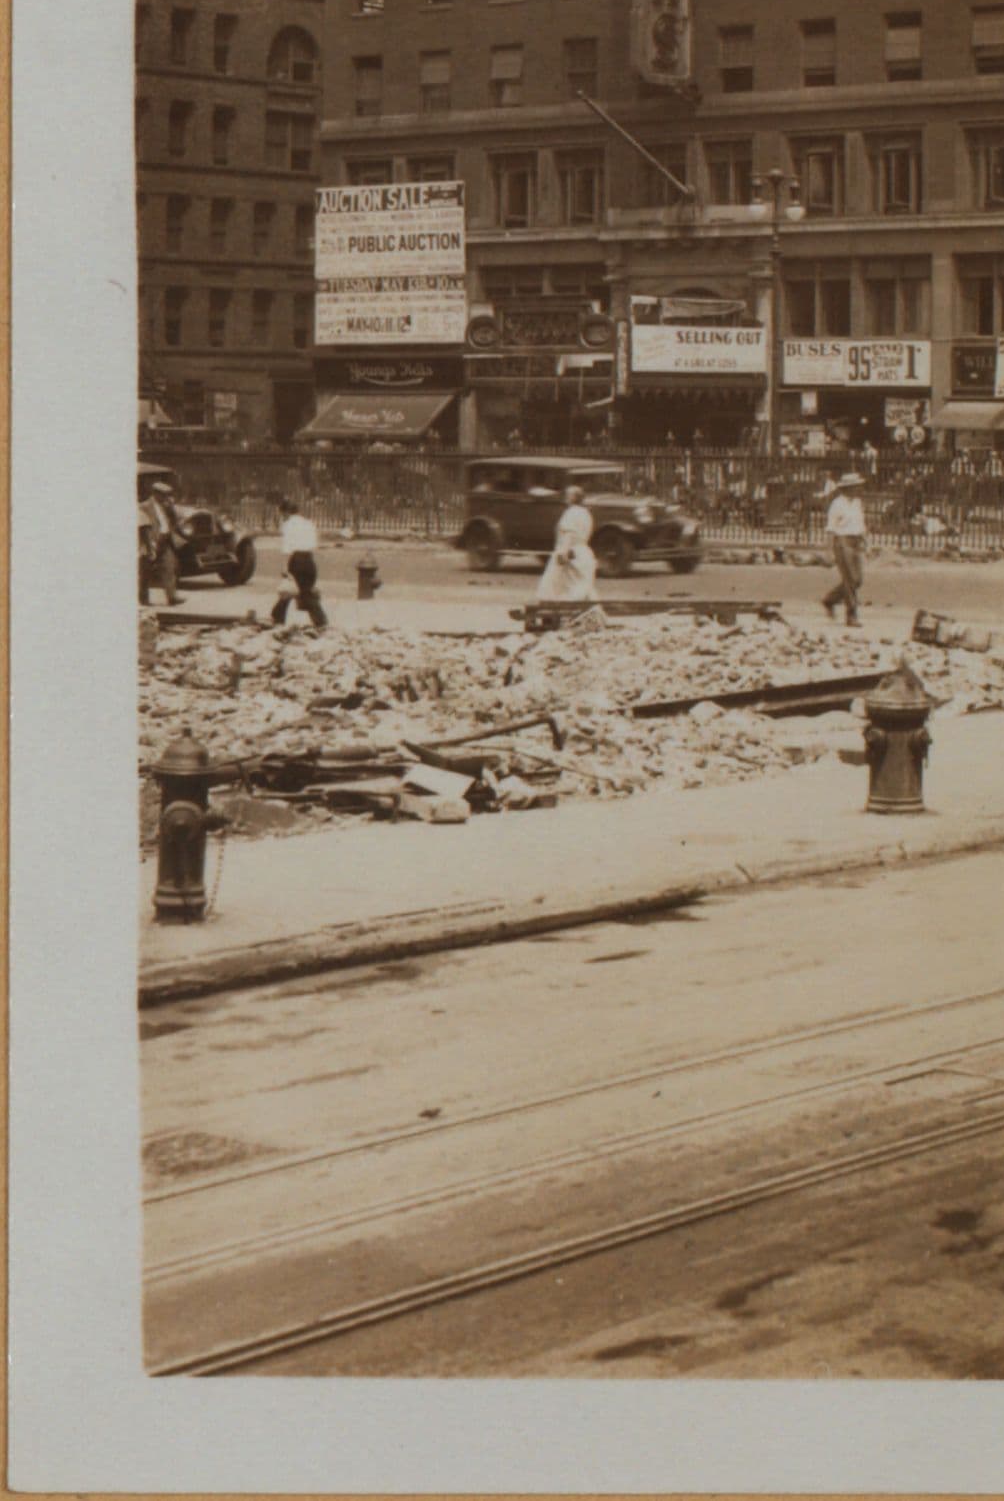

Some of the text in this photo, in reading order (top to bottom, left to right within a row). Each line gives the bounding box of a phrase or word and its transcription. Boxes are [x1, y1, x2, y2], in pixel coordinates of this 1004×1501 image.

[319, 188, 383, 213] AUCTION
[386, 185, 429, 211] SALE
[348, 234, 396, 253] PUBLIC
[398, 232, 461, 251] AUCTION
[675, 330, 762, 345] SELLING OUT
[848, 346, 871, 380] 95
